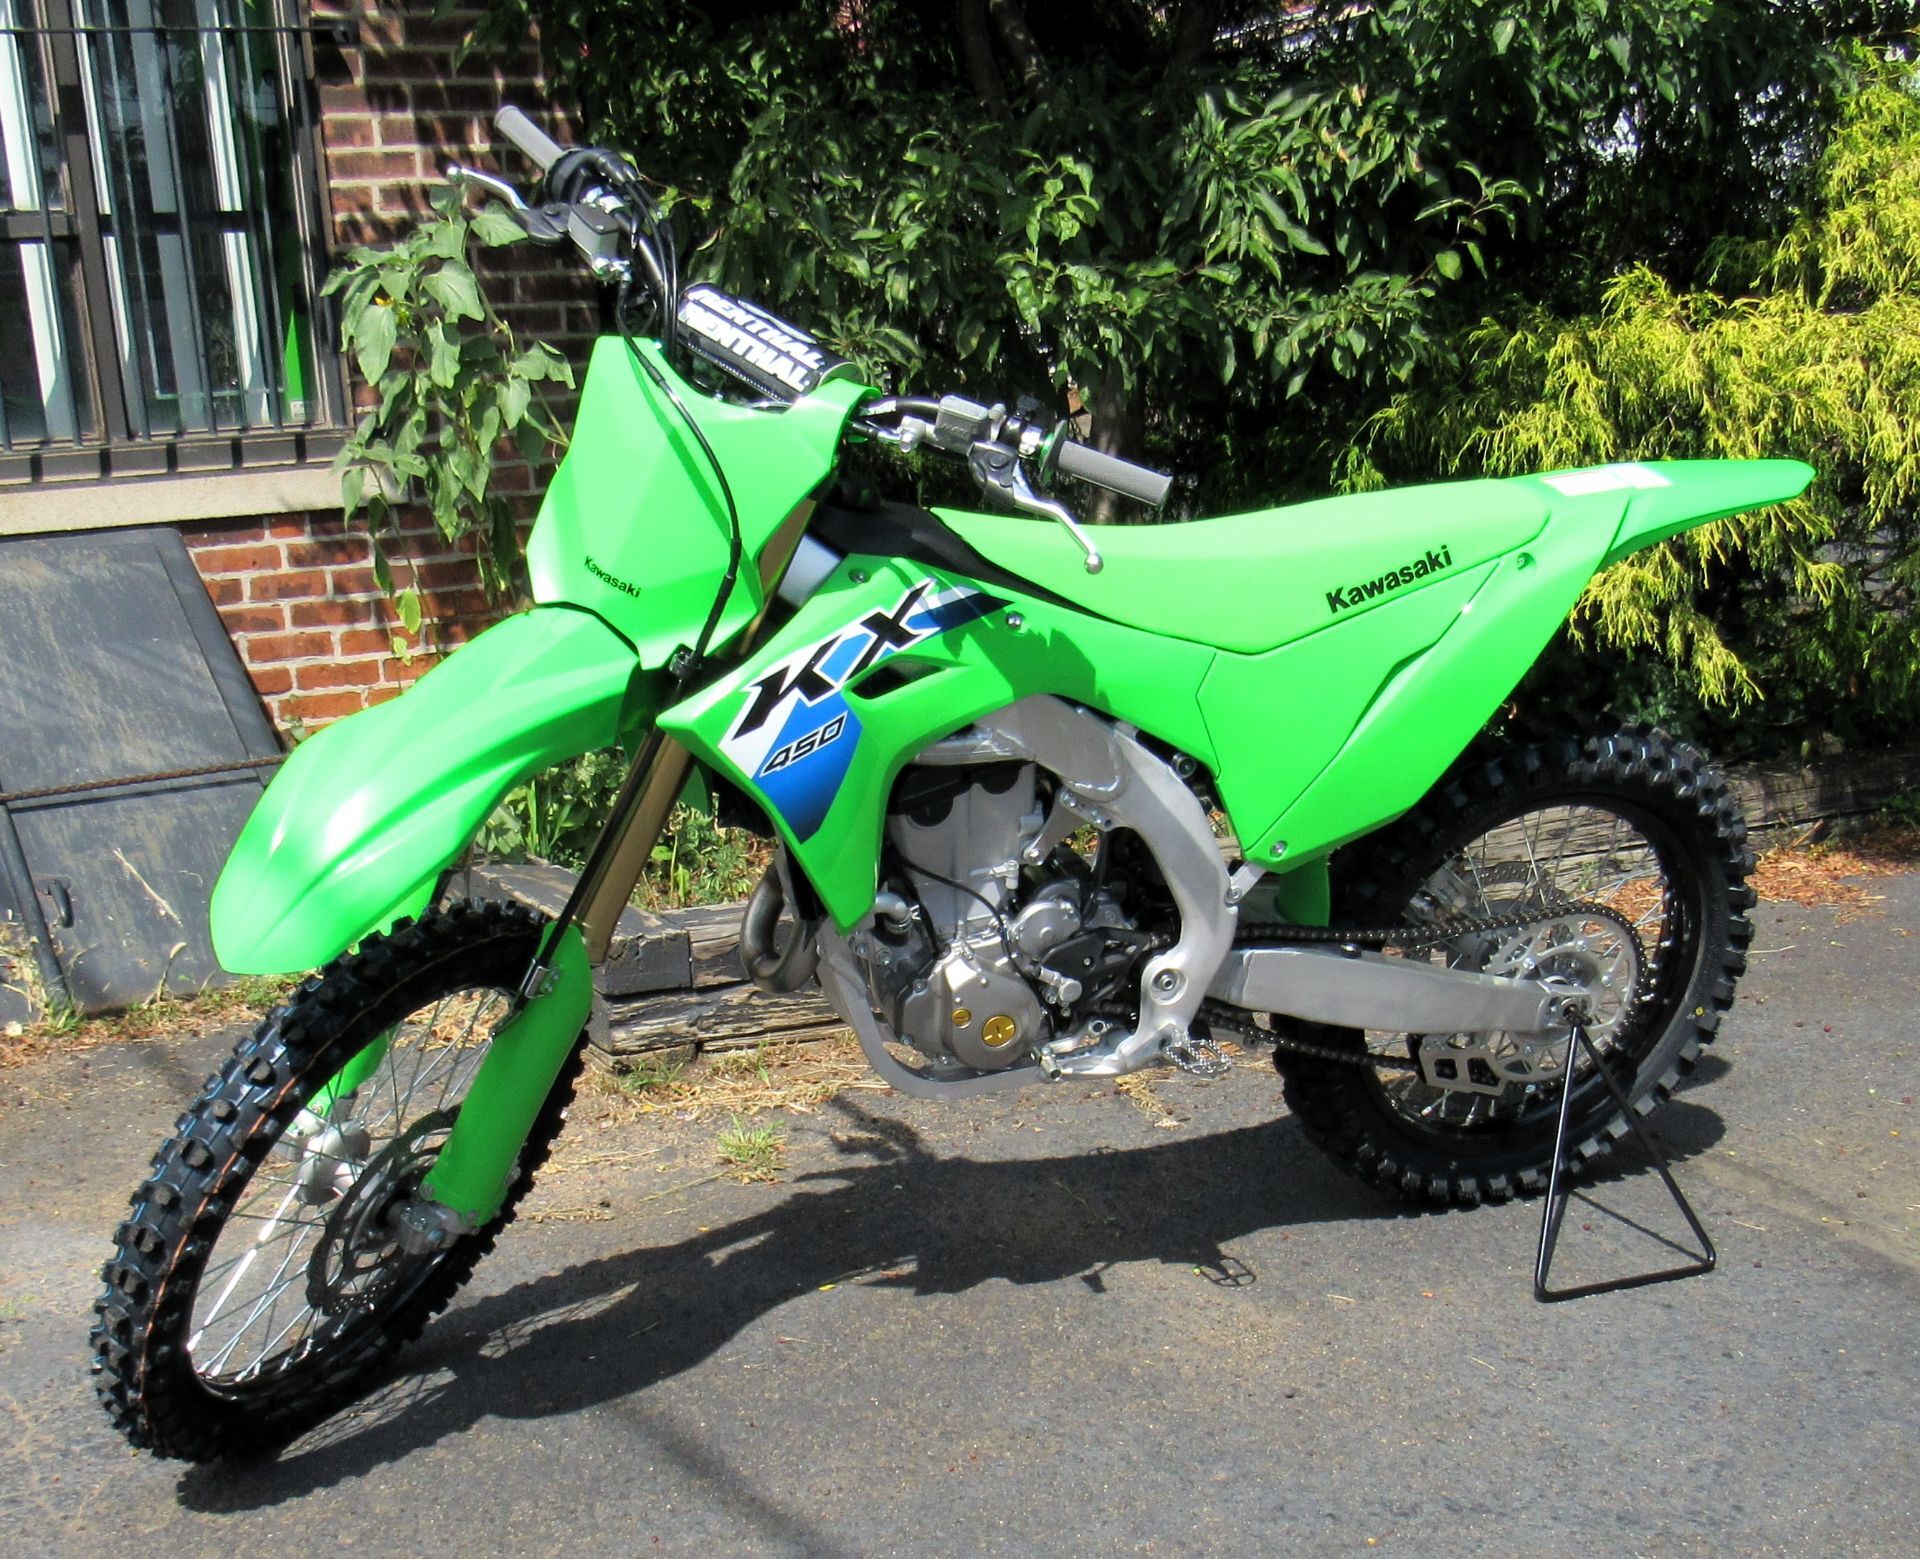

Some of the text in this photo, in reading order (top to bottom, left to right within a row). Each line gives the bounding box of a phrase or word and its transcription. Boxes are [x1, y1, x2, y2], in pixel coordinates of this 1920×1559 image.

[679, 301, 808, 392] RENTHAL
[688, 289, 822, 370] RENTHAL
[584, 555, 641, 598] Kawasaki
[1326, 544, 1453, 614] Kawasaki
[731, 578, 936, 742] KX
[759, 711, 848, 778] 450
